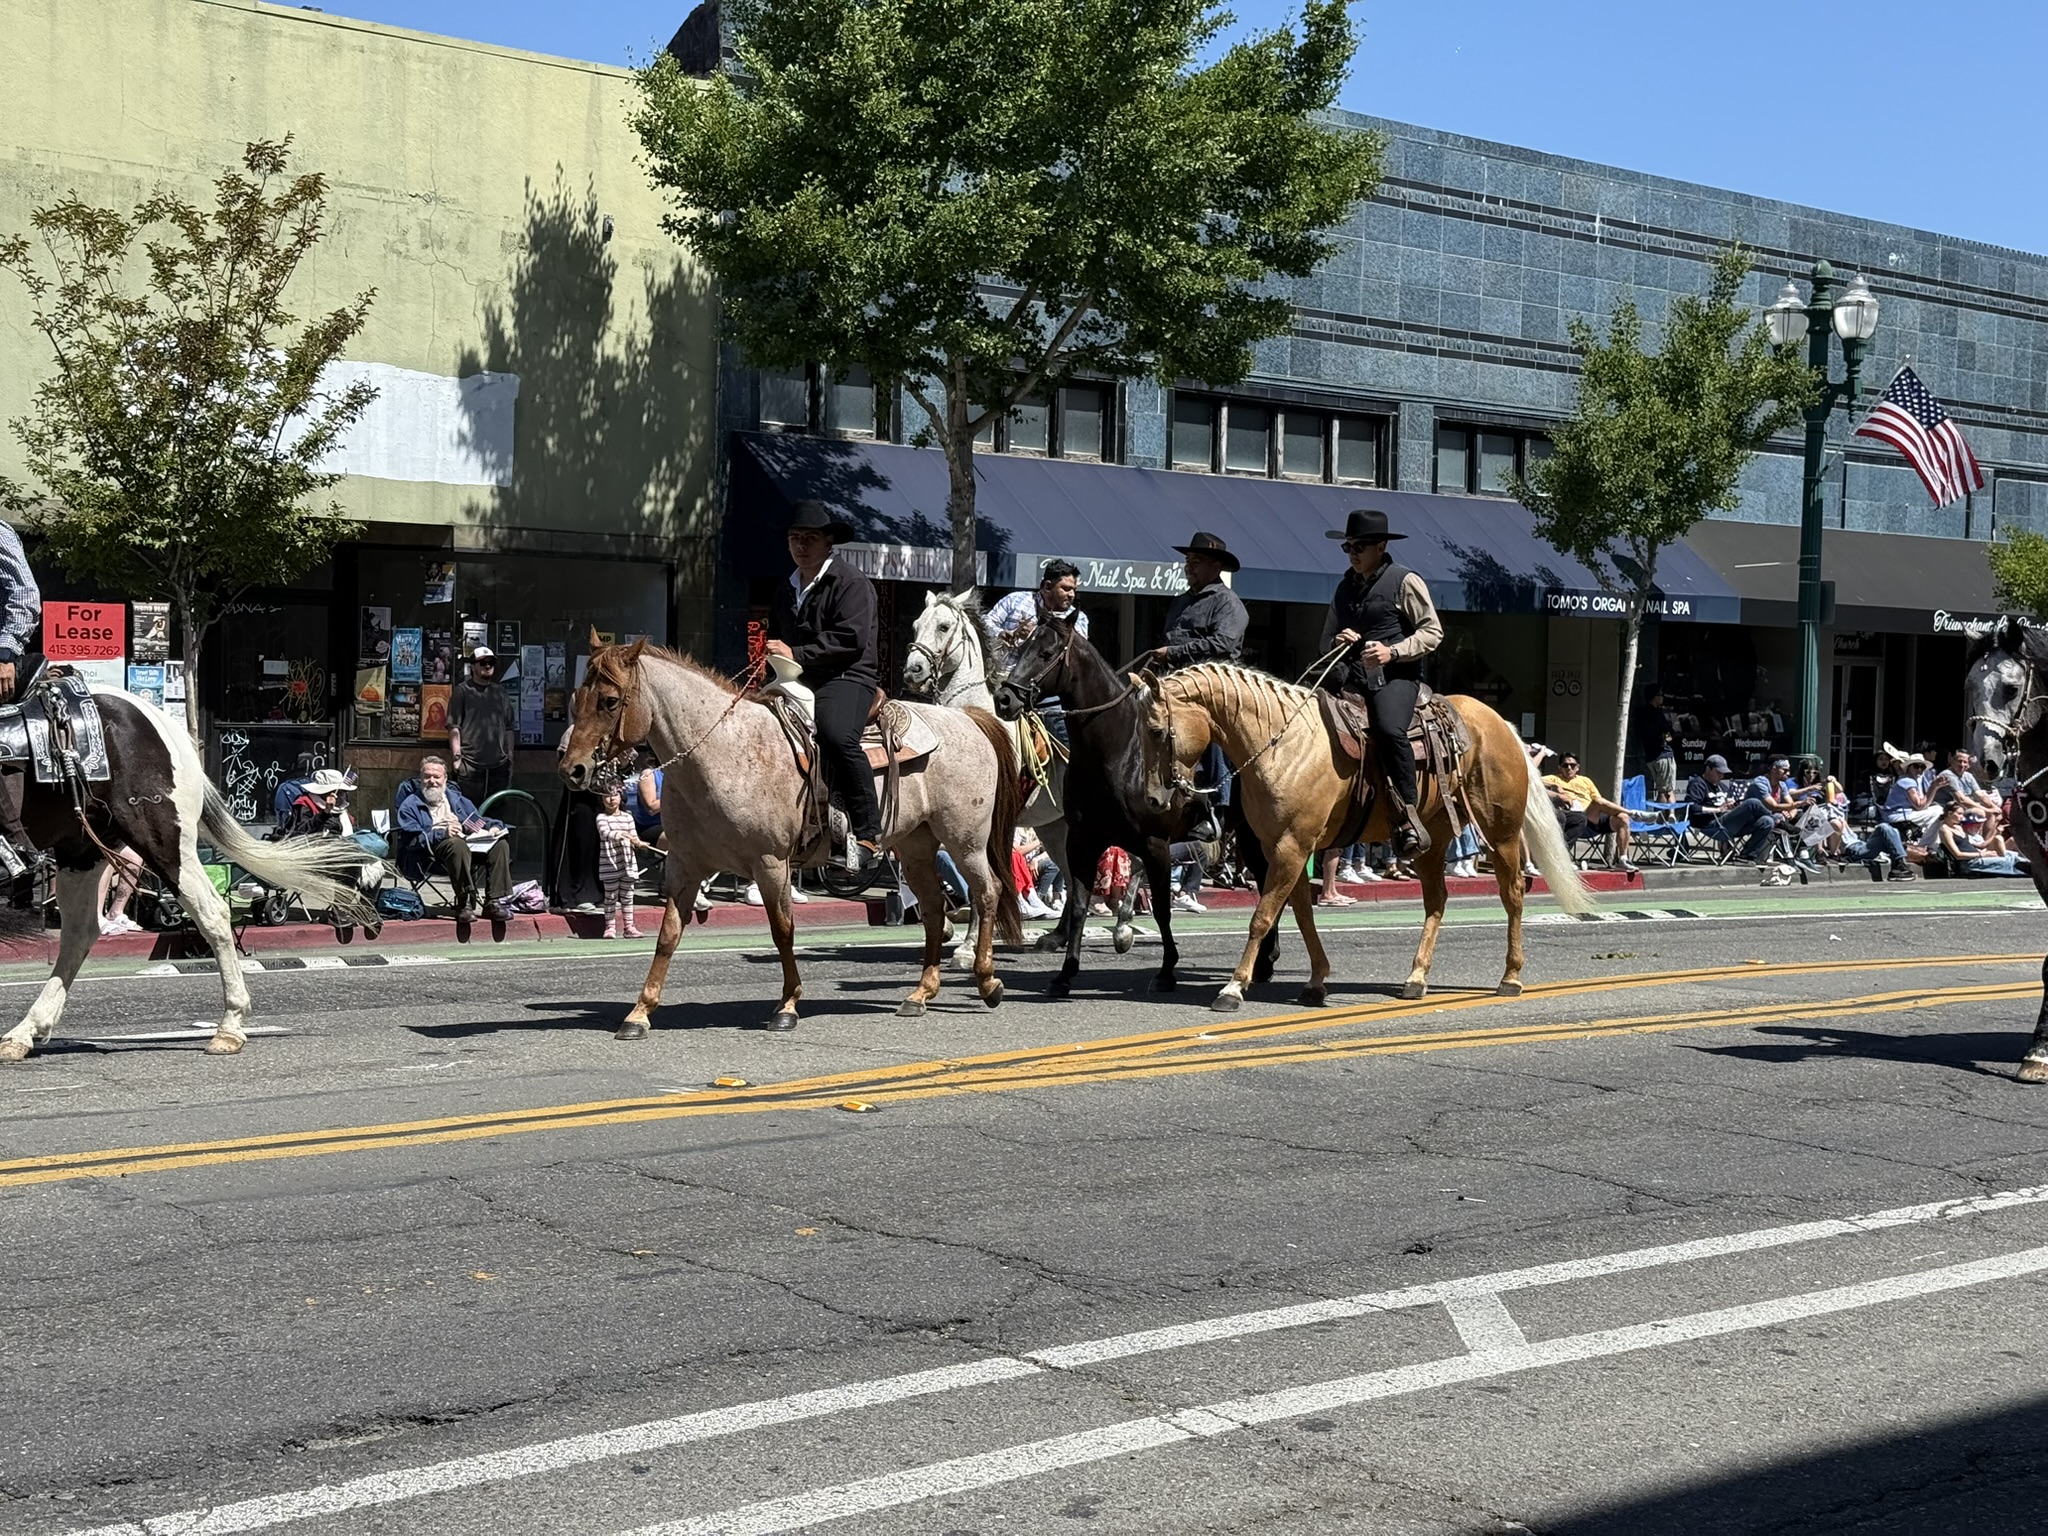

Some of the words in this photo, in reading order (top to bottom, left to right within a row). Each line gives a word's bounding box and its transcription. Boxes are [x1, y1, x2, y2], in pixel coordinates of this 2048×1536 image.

[1084, 560, 1118, 588] Nail
[1121, 566, 1147, 593] Spa
[1151, 565, 1162, 590] &
[1547, 594, 1588, 610] TOMO'S
[1646, 600, 1668, 614] NAIL
[1672, 601, 1690, 615] SPA
[67, 605, 102, 621] For
[55, 623, 114, 640] Lease
[48, 644, 121, 656] 415.395.7262
[1681, 738, 1707, 750] Sunday
[1734, 738, 1772, 751] Wednesday
[1683, 750, 1693, 761] 10
[1693, 753, 1705, 761] am
[1744, 750, 1750, 760] 7
[1750, 753, 1761, 763] pm
